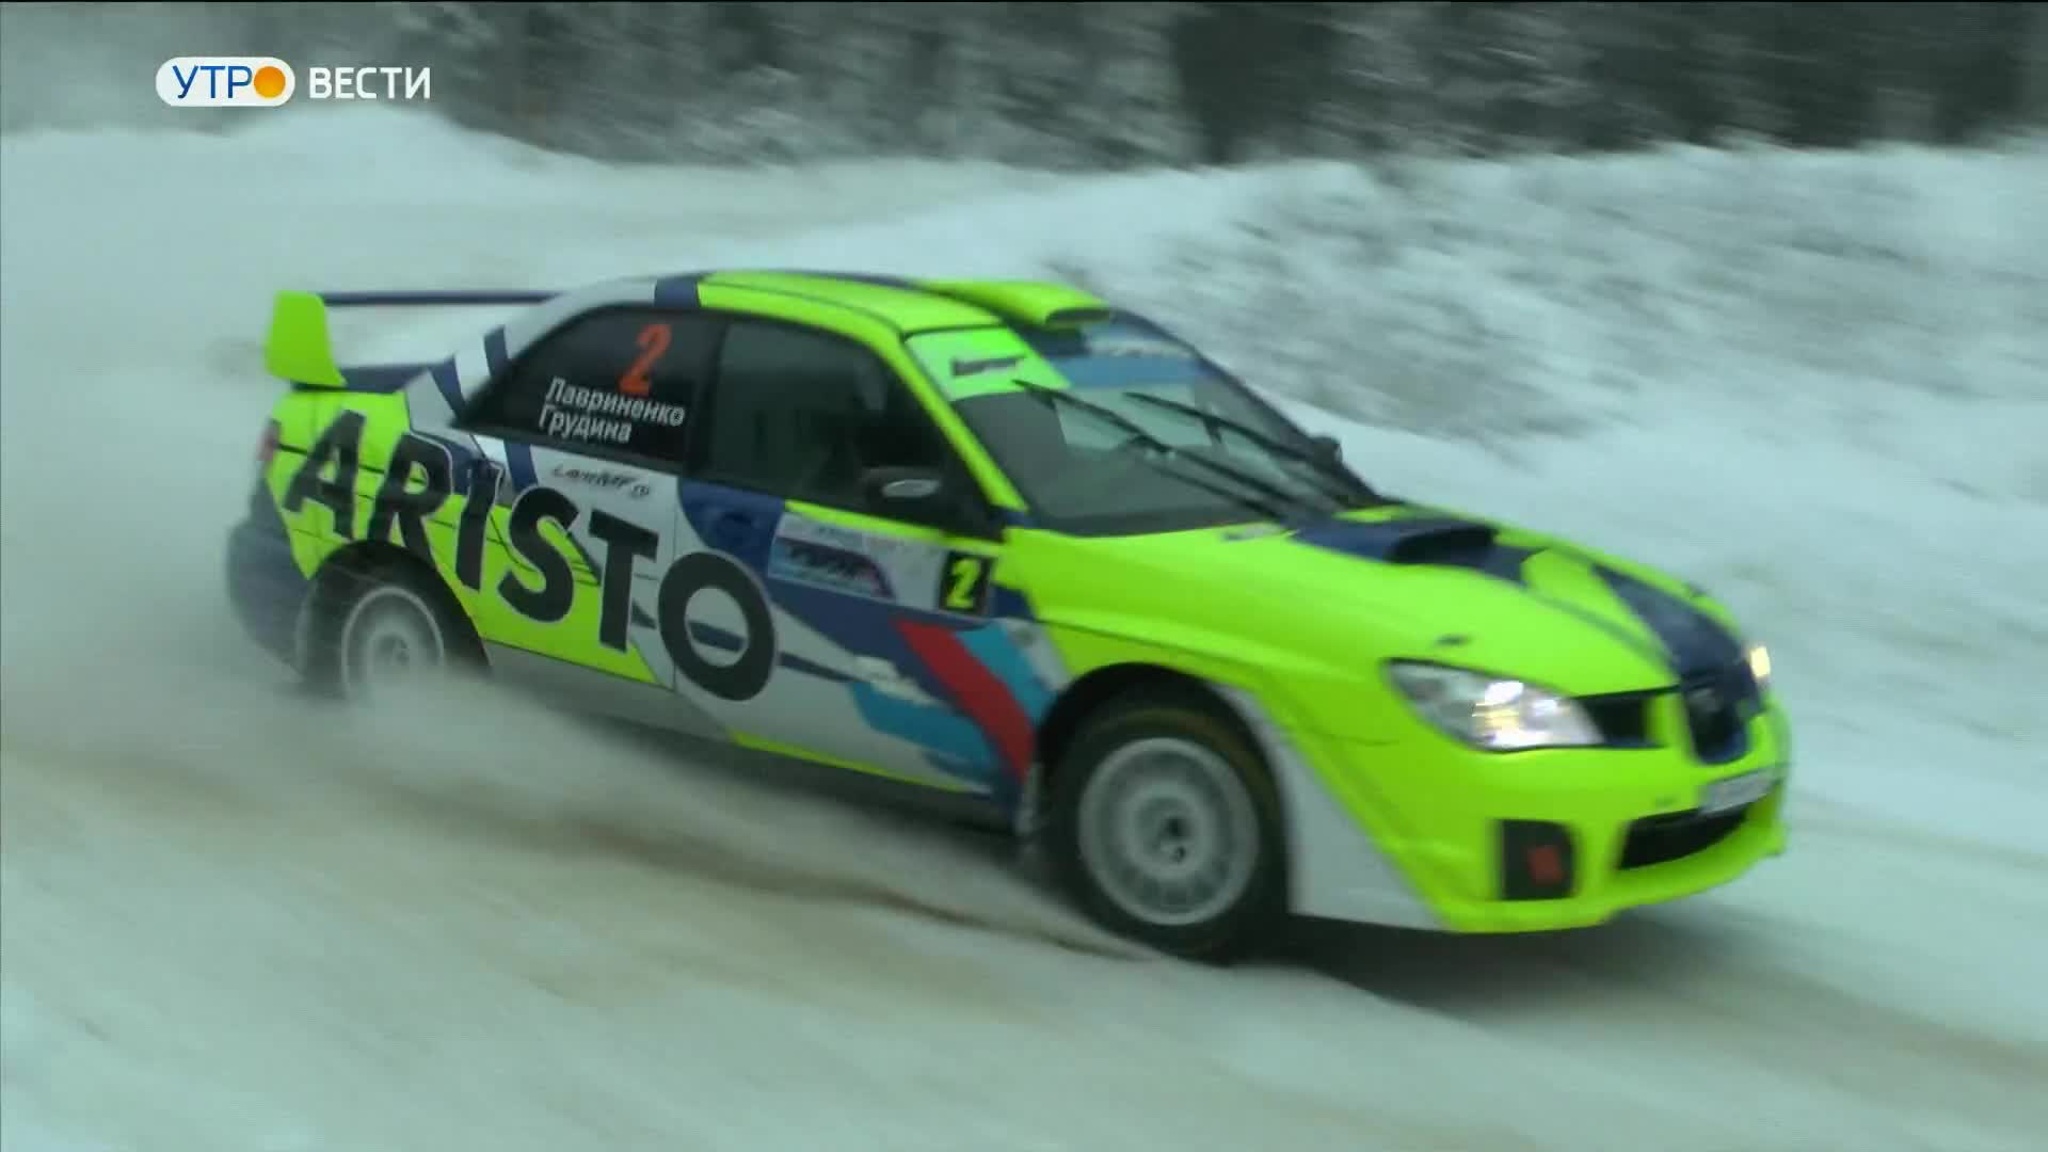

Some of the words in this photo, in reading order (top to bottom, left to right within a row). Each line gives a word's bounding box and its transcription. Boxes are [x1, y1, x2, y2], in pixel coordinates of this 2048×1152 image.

[618, 323, 672, 394] 2
[538, 404, 632, 443] Грудина
[545, 376, 685, 427] Лавриненко
[283, 409, 776, 702] ARISTO
[946, 558, 981, 608] 2
